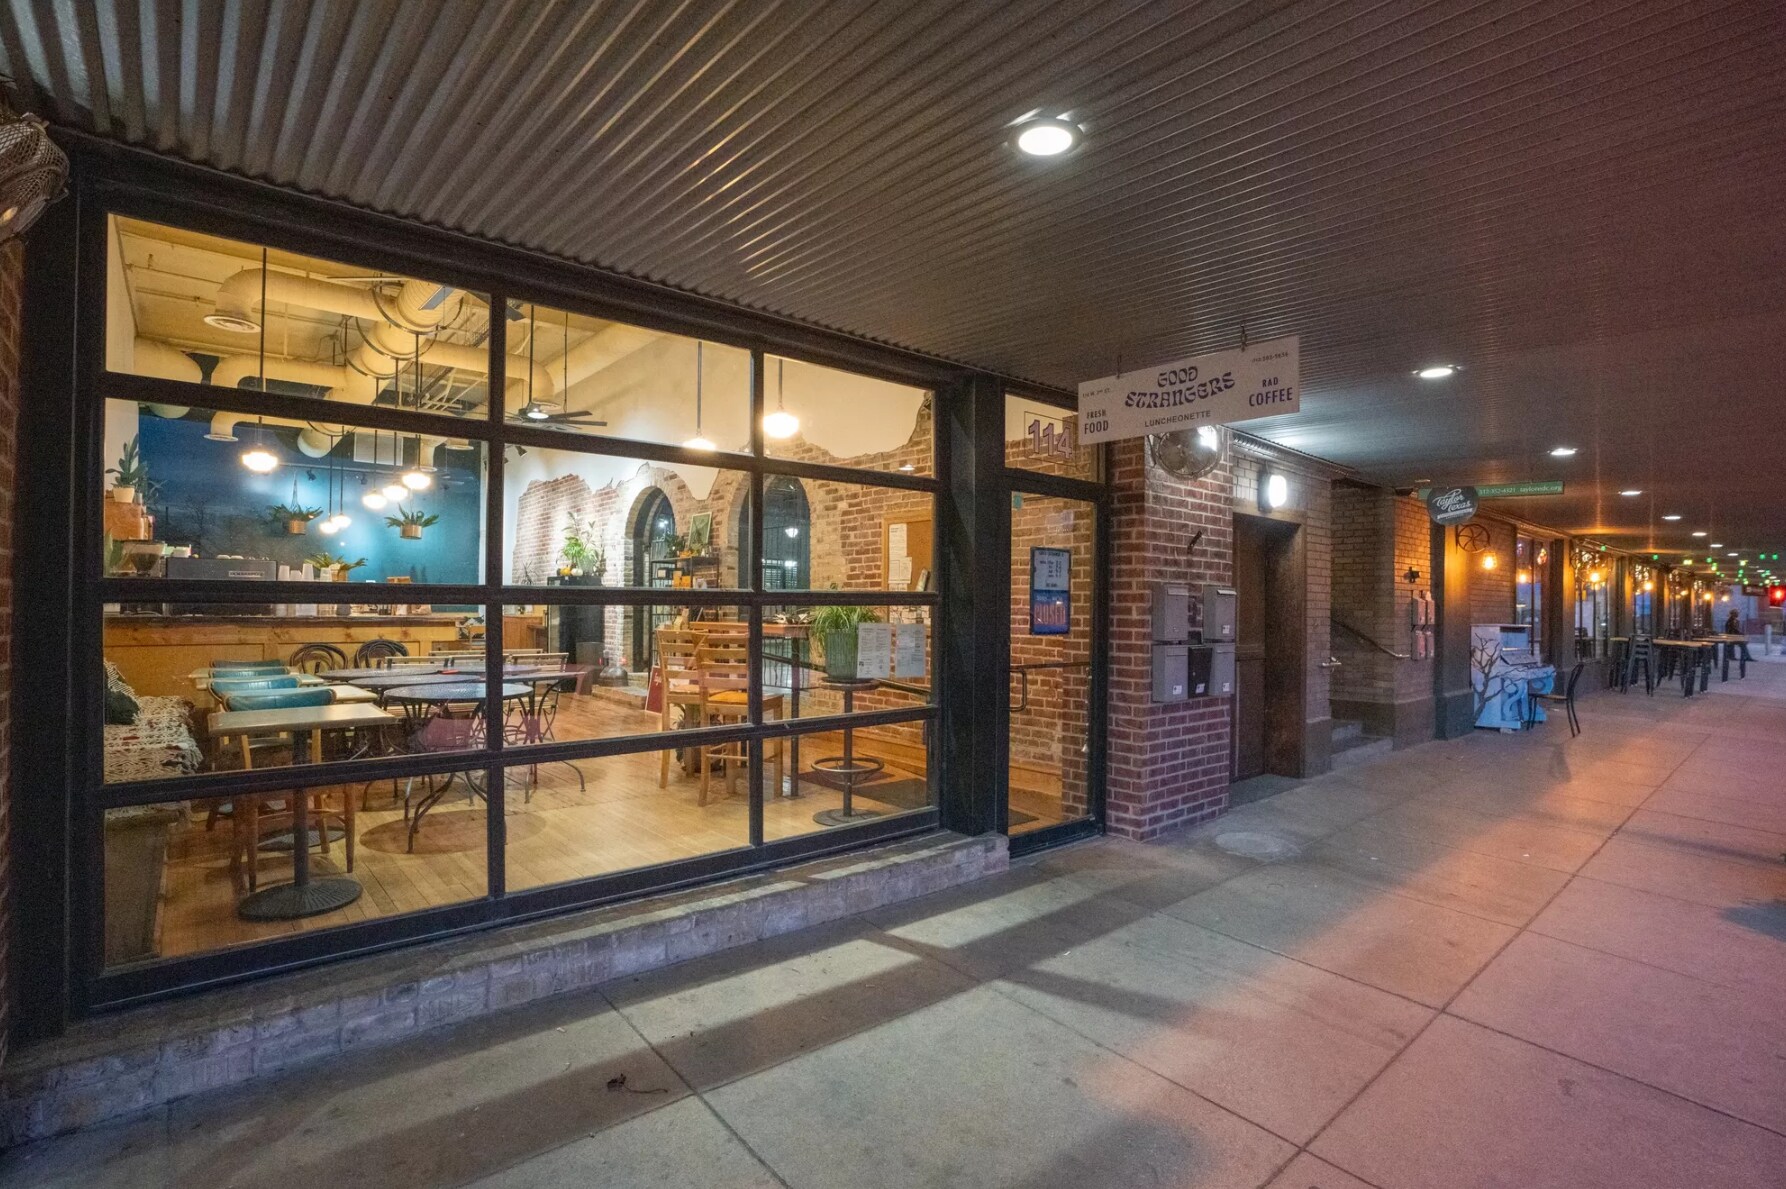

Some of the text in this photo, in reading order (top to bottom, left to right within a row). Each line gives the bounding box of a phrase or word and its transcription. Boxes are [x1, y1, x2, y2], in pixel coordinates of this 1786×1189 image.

[1157, 366, 1198, 388] GOOD
[1262, 377, 1279, 388] RAD
[1124, 372, 1236, 409] STRANGERS
[1248, 386, 1294, 407] COFFEE
[1086, 409, 1107, 420] FRESH
[1144, 411, 1212, 428] LUNCHEONETTE
[1084, 420, 1109, 435] FOOD
[1027, 418, 1073, 460] 114
[1432, 488, 1465, 511] Taylor
[1447, 500, 1471, 513] Texas
[1034, 603, 1066, 625] CLOSED
